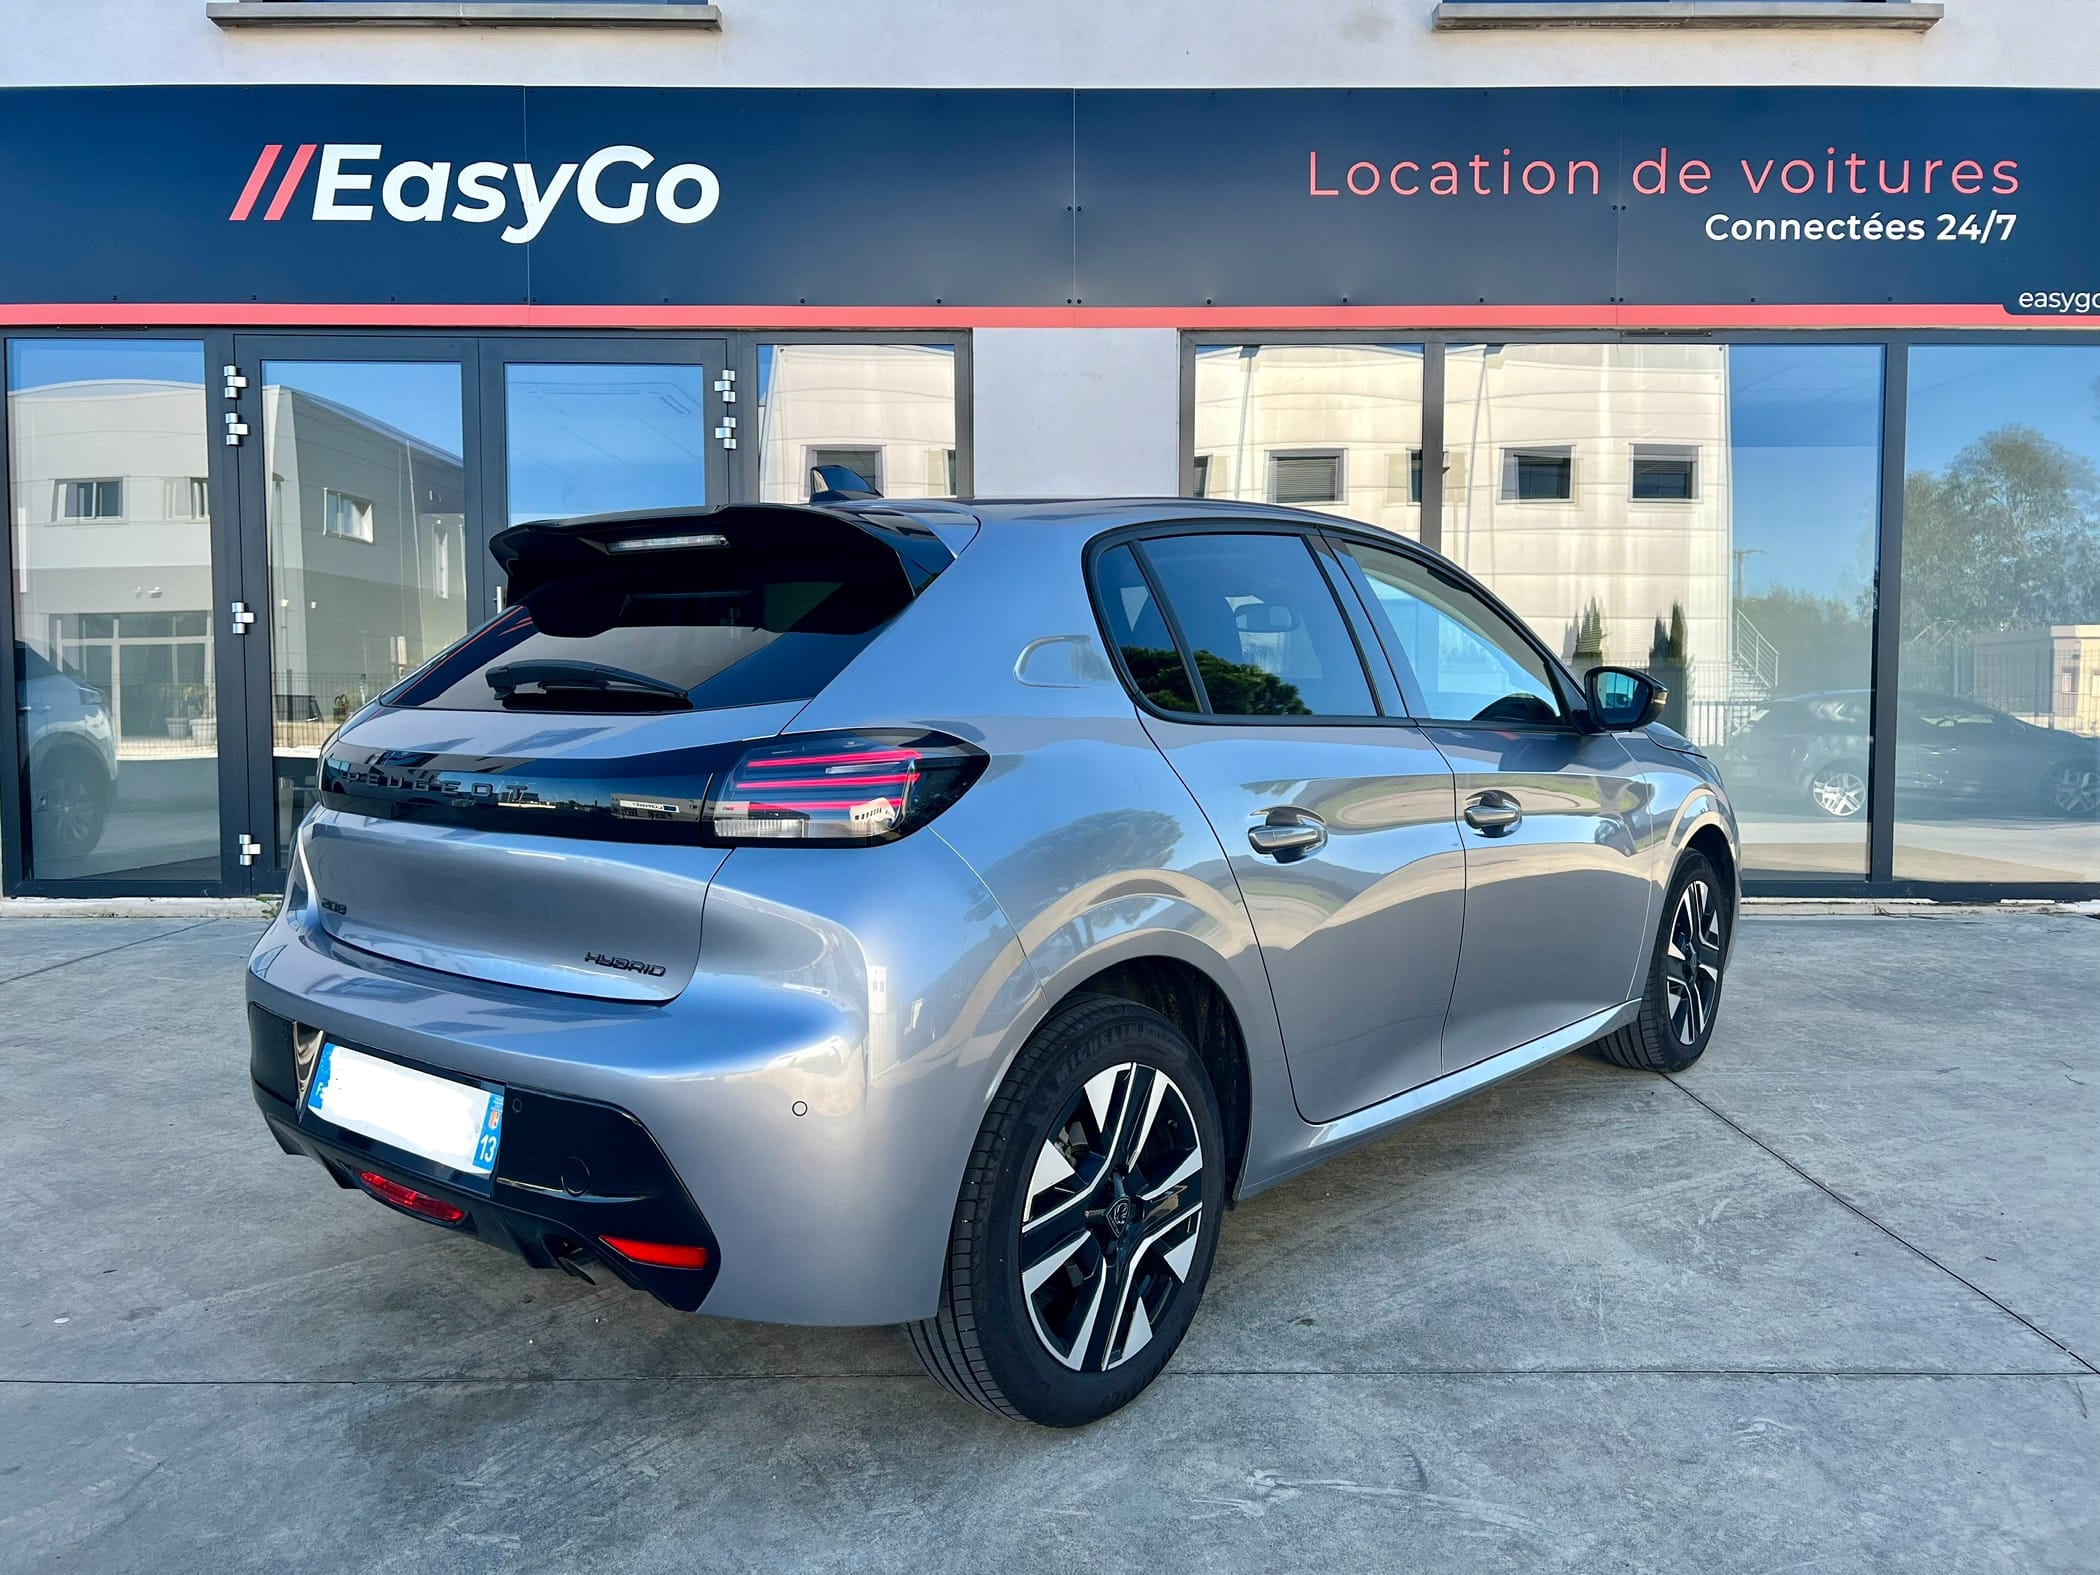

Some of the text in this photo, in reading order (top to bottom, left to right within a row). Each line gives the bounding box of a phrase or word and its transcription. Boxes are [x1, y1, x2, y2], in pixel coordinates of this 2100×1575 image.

[1309, 146, 2020, 197] Location de voitures
[1704, 209, 2018, 244] Connectées 24/7
[346, 771, 528, 800] PEUGEOT
[321, 897, 348, 916] 208
[584, 951, 666, 977] HYBRID
[479, 1133, 498, 1163] 13
